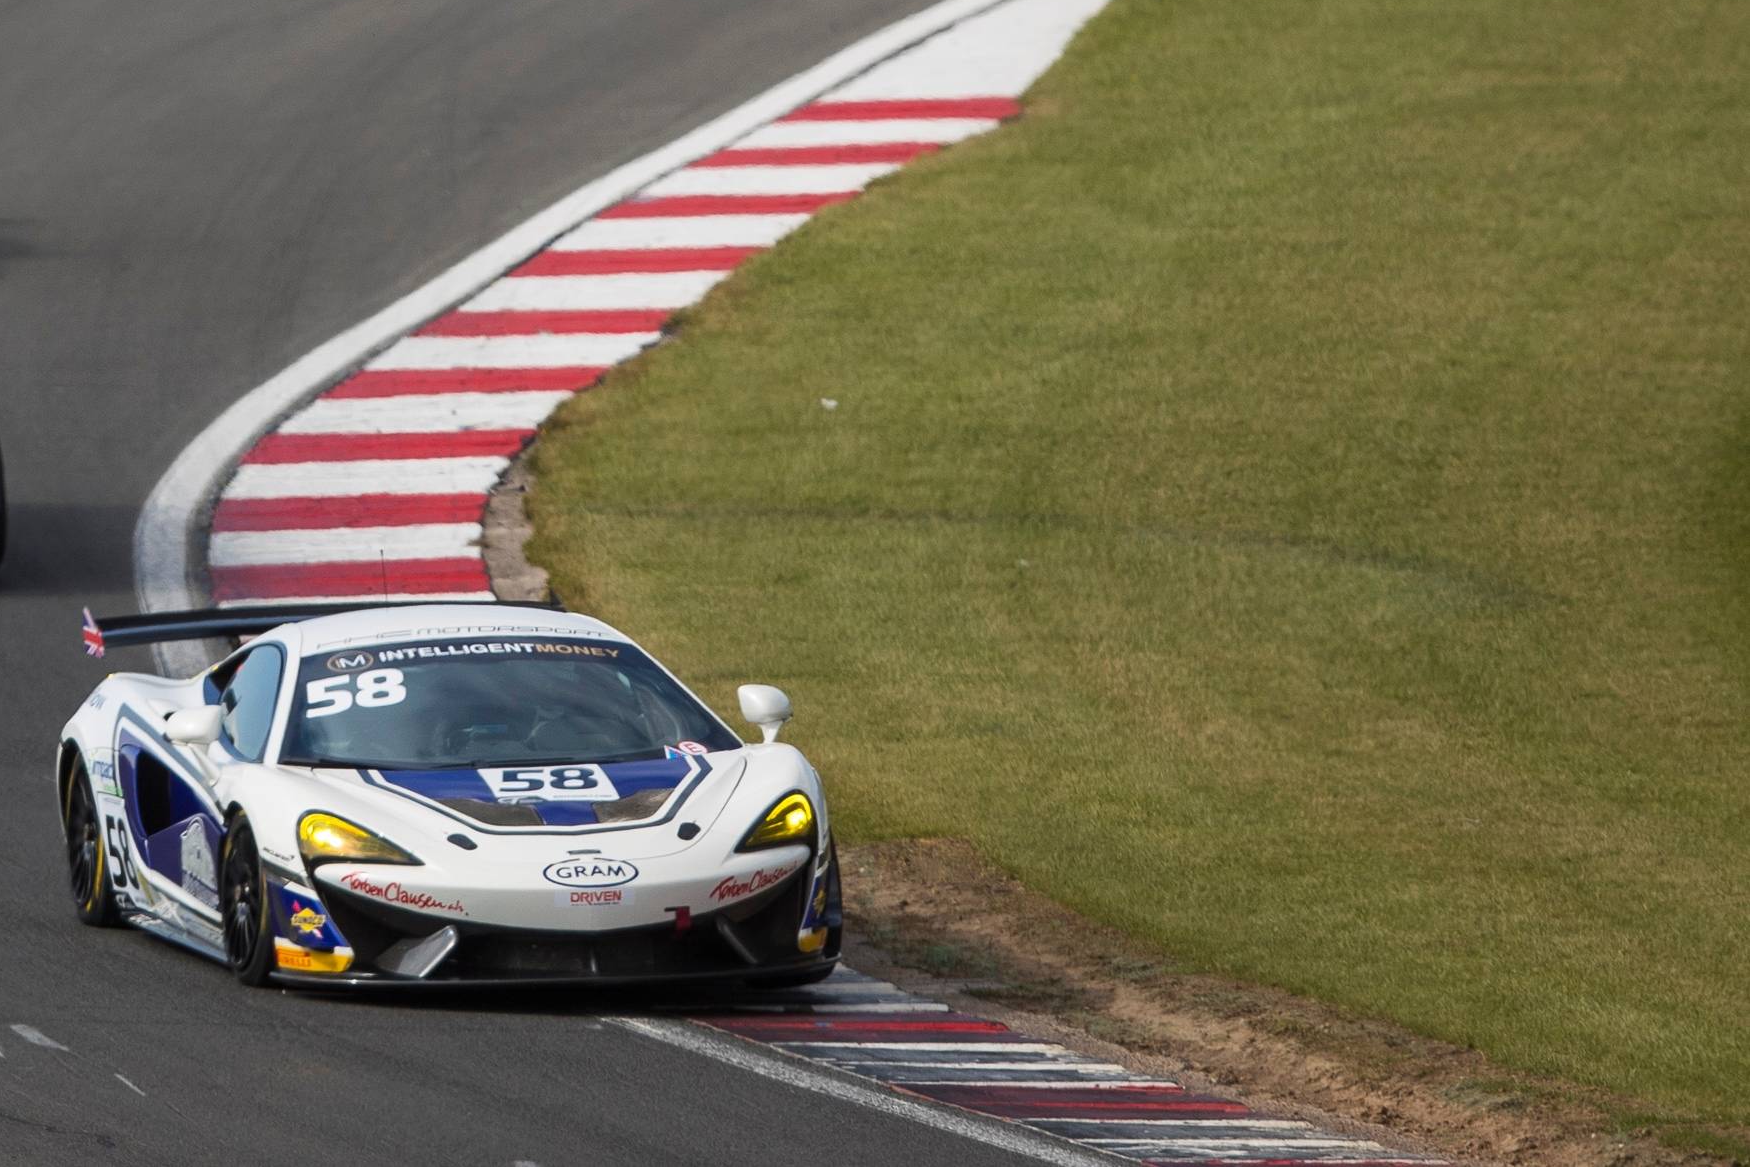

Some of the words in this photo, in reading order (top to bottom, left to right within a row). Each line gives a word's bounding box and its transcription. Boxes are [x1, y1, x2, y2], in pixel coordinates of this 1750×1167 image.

[378, 642, 619, 663] INTELLIGENTMONEY
[305, 668, 407, 718] 58
[499, 768, 598, 792] 58
[105, 814, 140, 890] 58
[556, 865, 626, 878] GRAM
[384, 882, 446, 908] Clausen
[570, 891, 622, 905] DRIVEN
